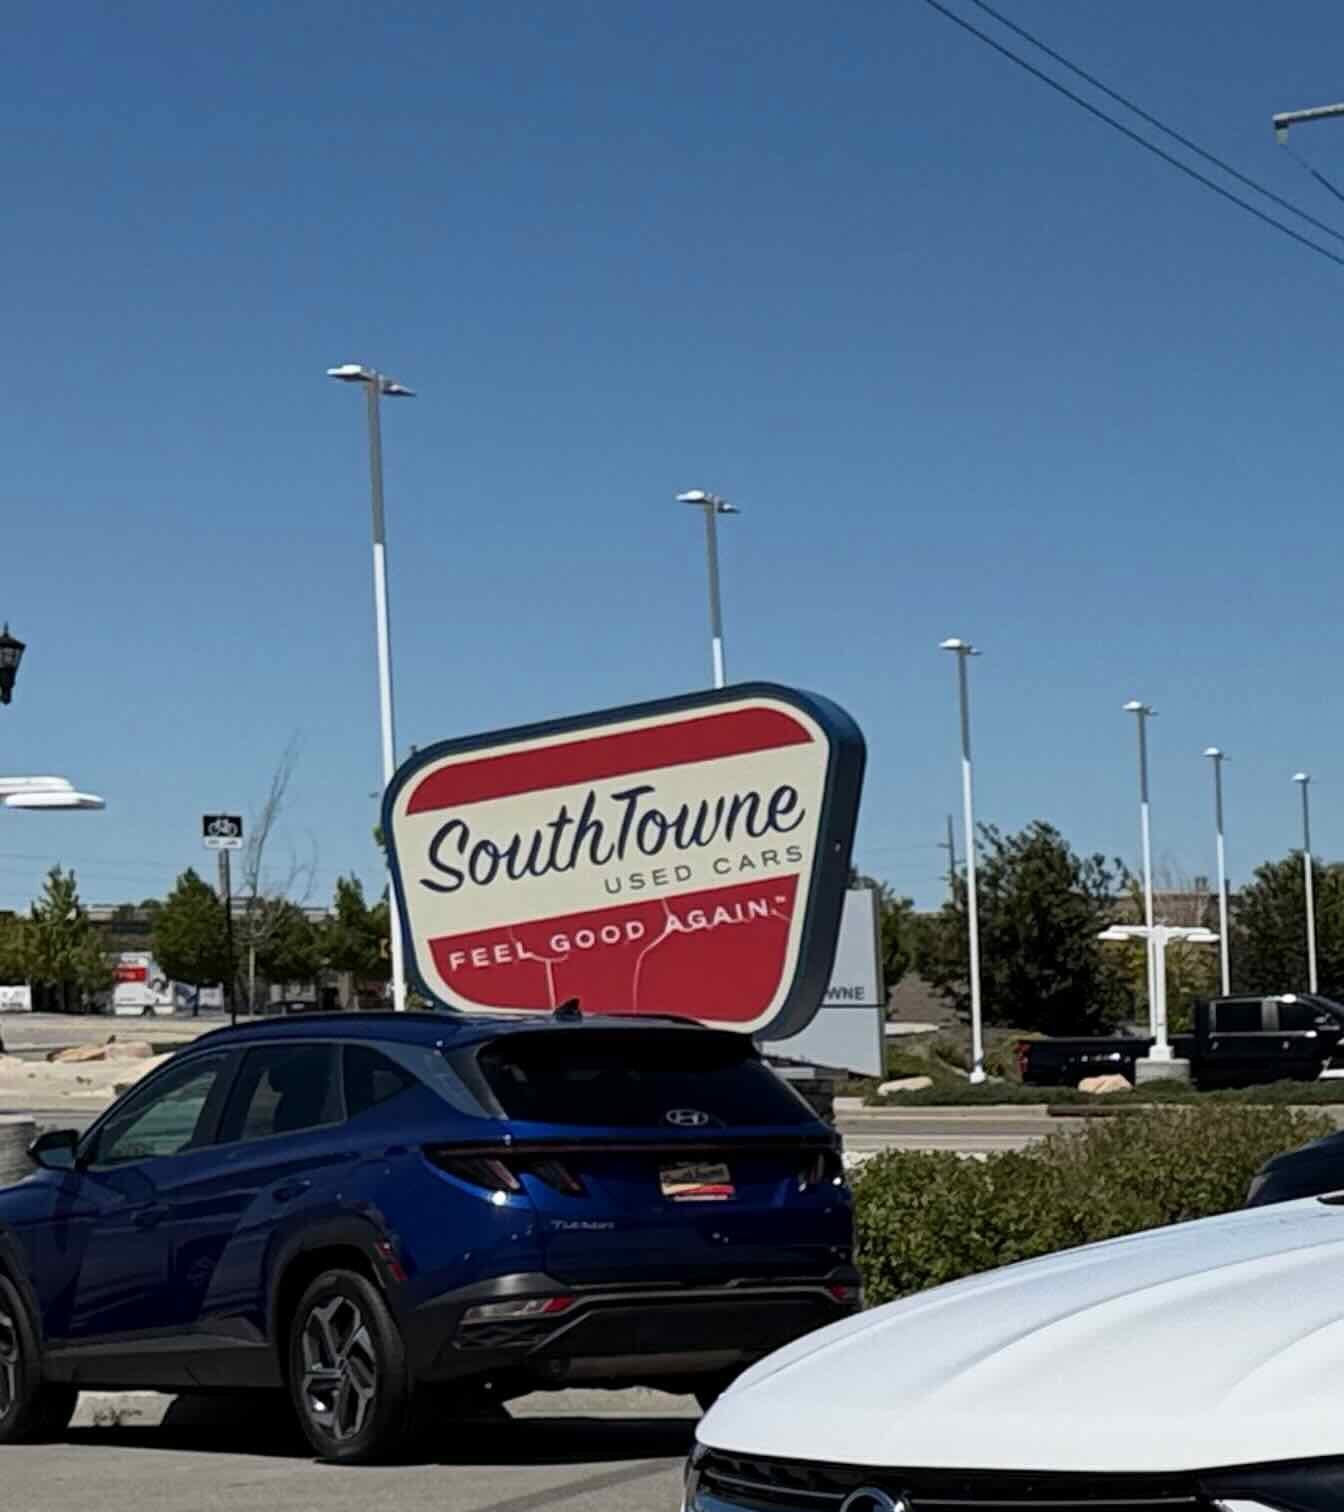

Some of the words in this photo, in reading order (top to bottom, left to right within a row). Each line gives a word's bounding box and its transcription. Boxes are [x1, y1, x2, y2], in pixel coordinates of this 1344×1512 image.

[419, 784, 806, 894] SouthTowne
[604, 864, 692, 895] USED
[713, 845, 803, 875] CARS
[448, 937, 533, 971] FEEL
[549, 921, 645, 953] GOOD
